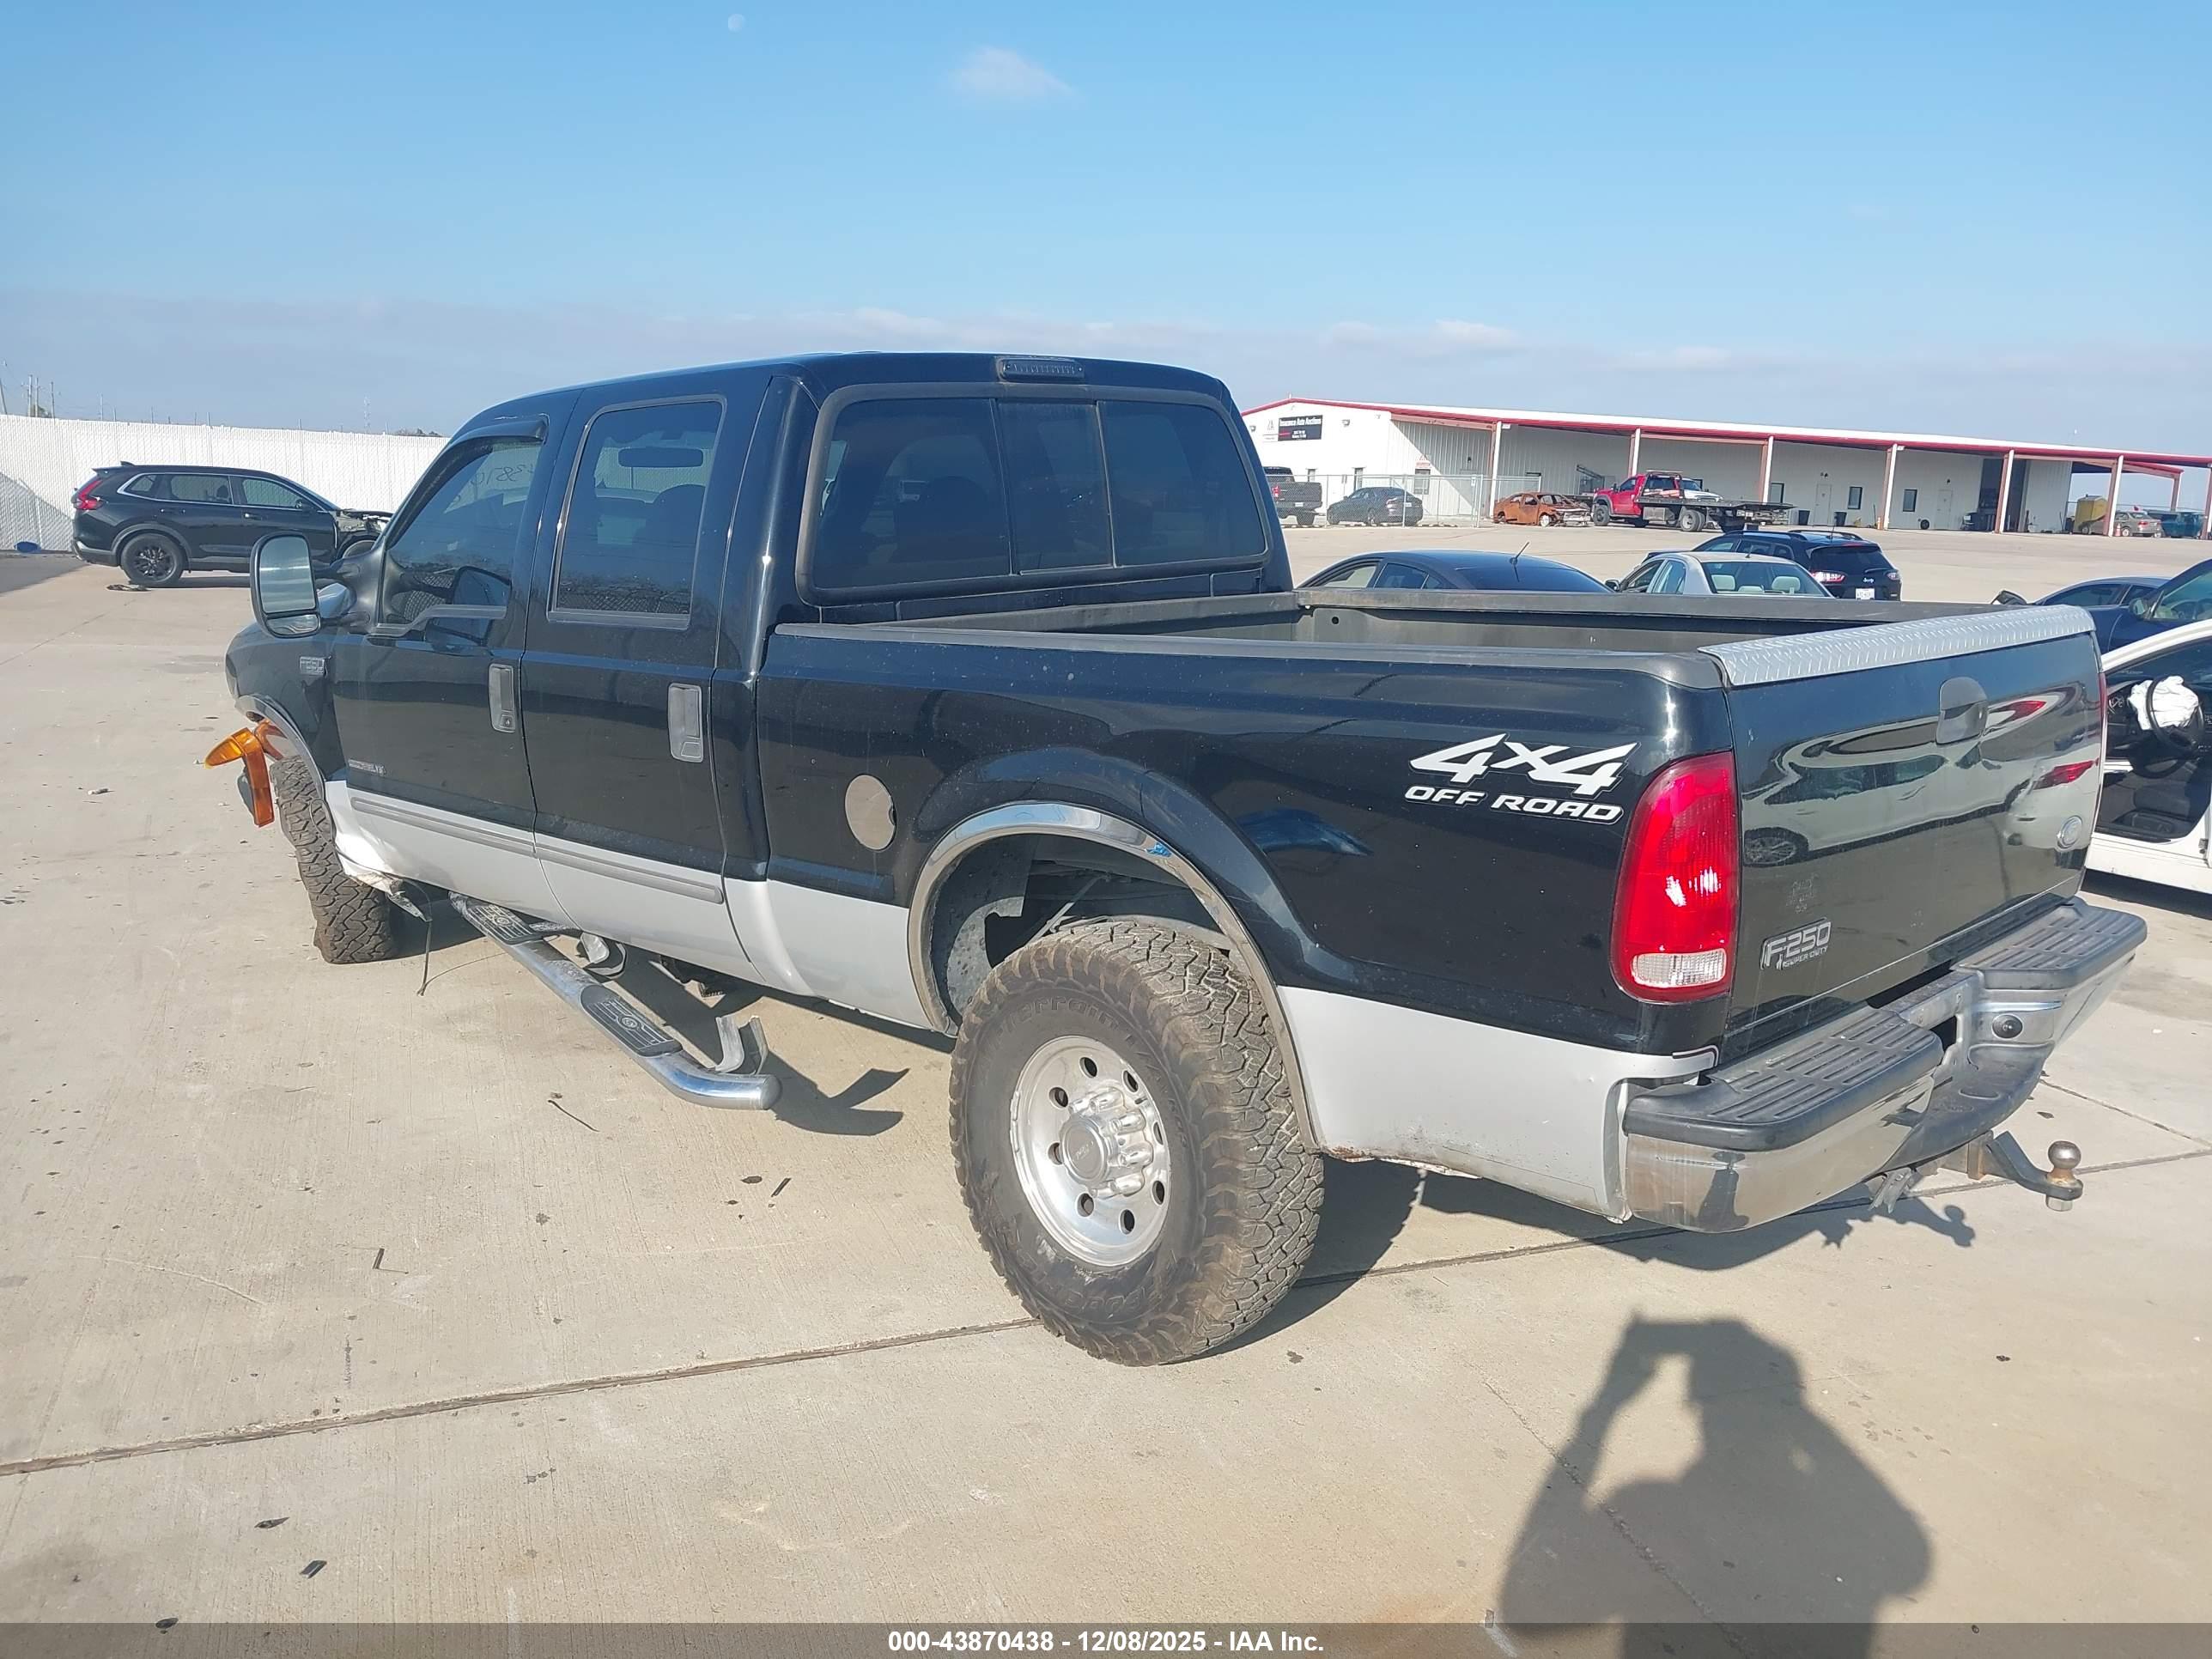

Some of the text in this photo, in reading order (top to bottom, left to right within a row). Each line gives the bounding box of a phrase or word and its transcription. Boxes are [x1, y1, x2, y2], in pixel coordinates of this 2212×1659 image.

[1405, 785, 1623, 821] OFF ROAD
[1783, 946, 1829, 968] SUPER DUTY
